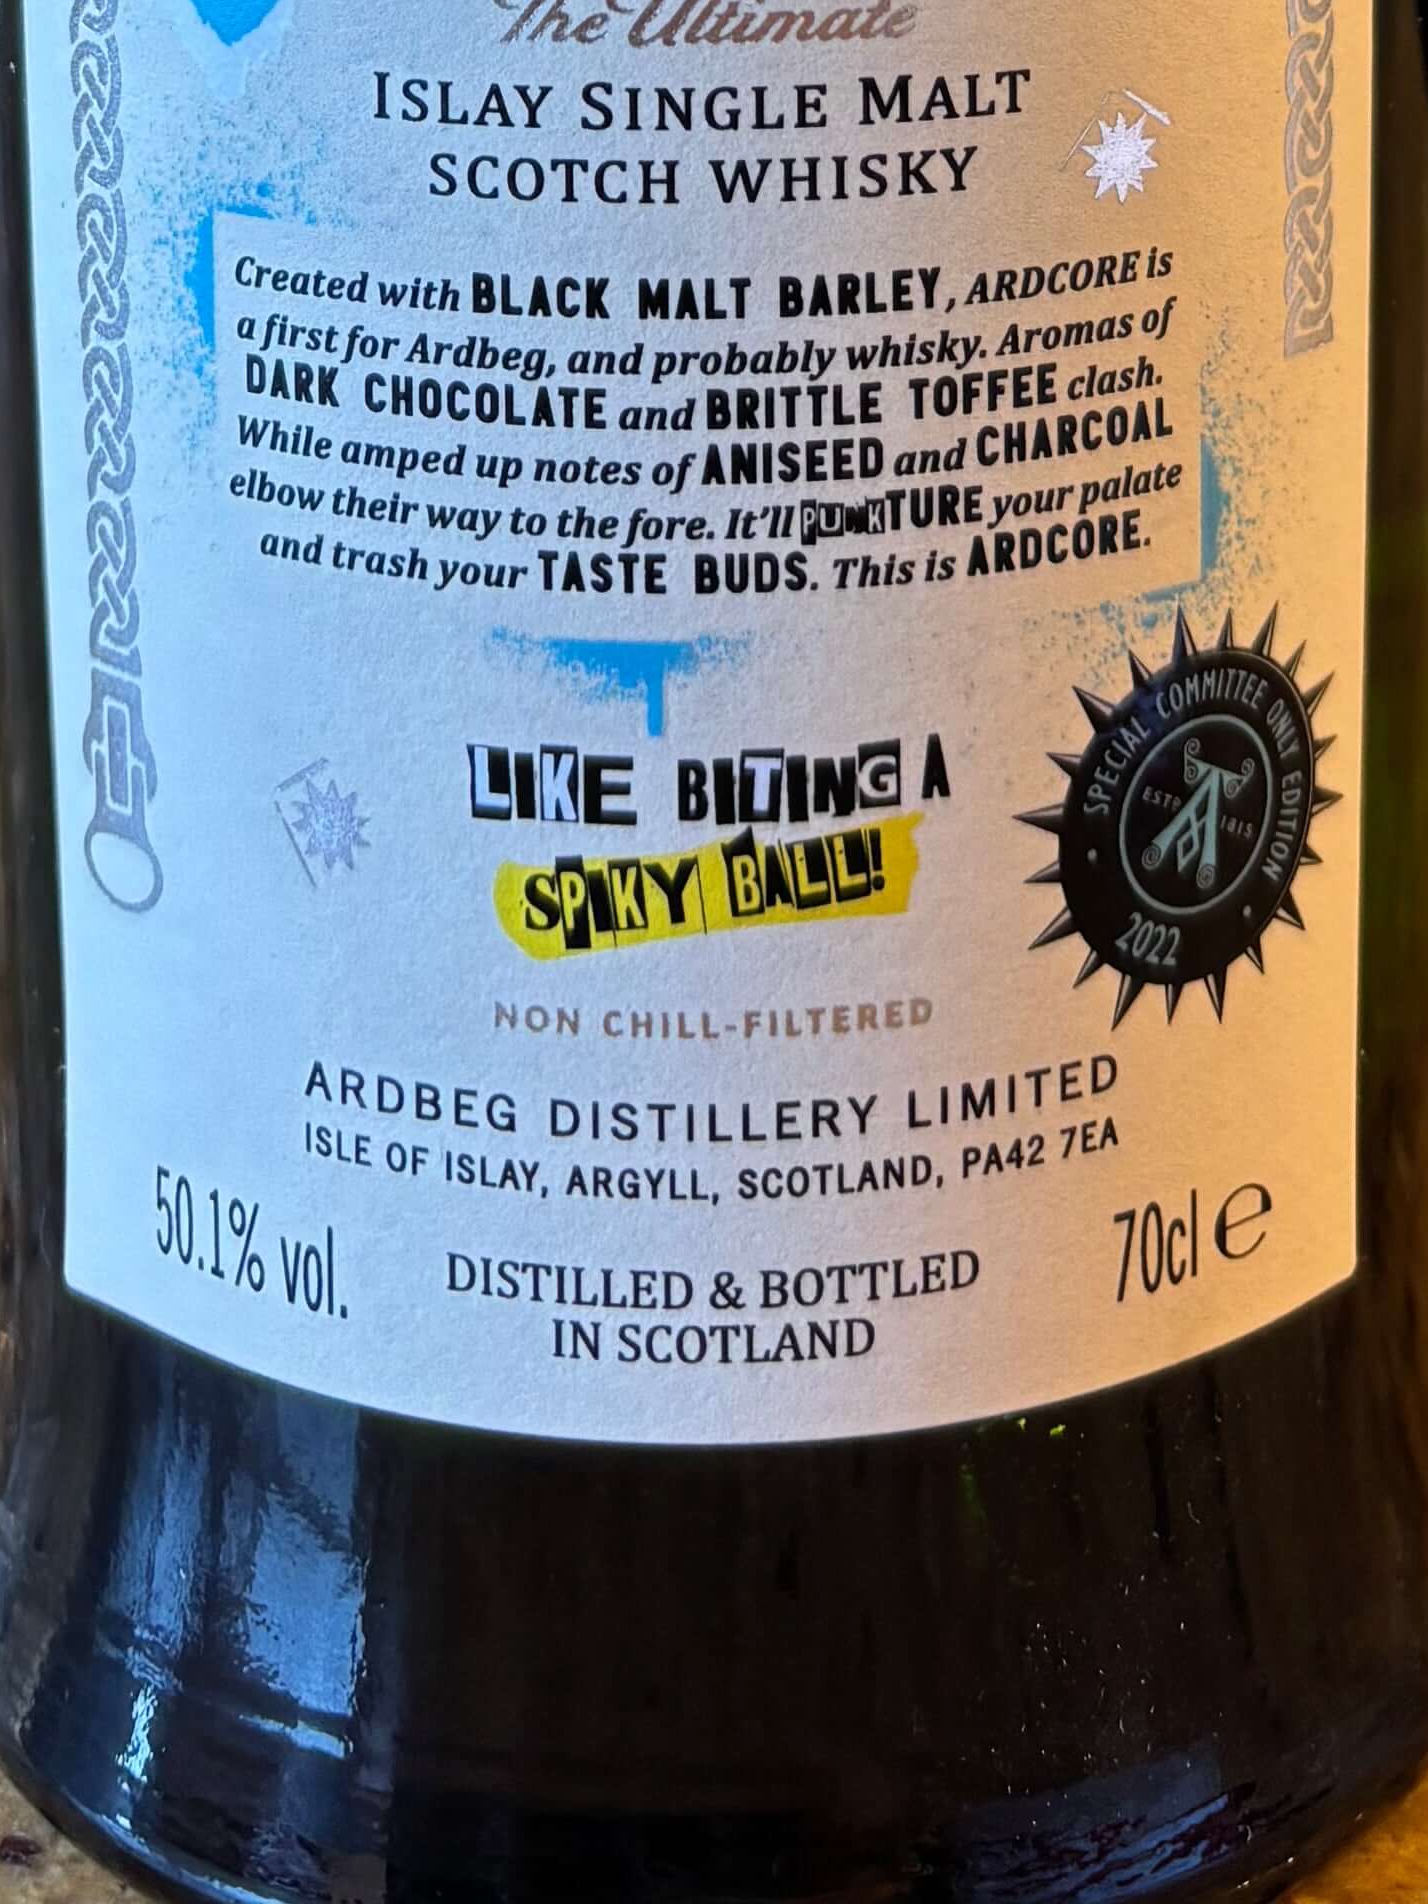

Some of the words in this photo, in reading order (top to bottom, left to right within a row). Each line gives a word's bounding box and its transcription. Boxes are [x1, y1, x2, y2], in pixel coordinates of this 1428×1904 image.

[374, 71, 553, 128] ISLAY
[581, 81, 827, 131] SINGLE
[858, 69, 1030, 125] MALT
[430, 153, 680, 205] SCOTCH
[708, 146, 978, 204] WHISKY
[235, 256, 369, 303] Created
[378, 277, 460, 312] with
[472, 272, 610, 319] BLACK
[638, 277, 751, 320] MALT
[779, 266, 956, 318] BARLEY,
[964, 250, 1141, 305] ARDCORE
[1146, 246, 1173, 278] is
[237, 317, 256, 340] a
[259, 313, 339, 353] first
[340, 325, 400, 364] for
[404, 333, 556, 381] Ardbeg,
[567, 343, 644, 376] and
[651, 339, 837, 384] probably
[846, 330, 987, 371] whisky.
[995, 313, 1134, 356] Aromas
[1141, 296, 1177, 340] of
[246, 353, 340, 408] DARK
[365, 373, 607, 429] CHOCOLATE
[618, 398, 696, 431] and
[707, 381, 882, 430] BRITTLE
[908, 362, 1057, 420] TOFFEE
[1067, 355, 1162, 401] clash.
[238, 414, 332, 460] While
[341, 440, 467, 479] amped
[476, 454, 523, 488] up
[533, 456, 642, 486] notes
[652, 453, 697, 495] of
[701, 437, 883, 485] ANISEED
[894, 437, 967, 477] and
[976, 397, 1173, 467] CHARCOAL
[230, 468, 325, 512] elbow
[332, 485, 419, 525] their
[426, 504, 502, 541] way
[510, 507, 547, 536] to
[557, 506, 619, 539] the
[620, 508, 715, 549] fore.
[987, 485, 1074, 530] your
[1078, 462, 1183, 515] palate
[260, 534, 324, 565] and
[333, 541, 428, 580] trash
[434, 560, 528, 591] your
[537, 550, 667, 595] TASTE
[695, 551, 818, 595] BUDS.
[833, 554, 915, 590] This
[924, 550, 956, 582] is
[967, 508, 1151, 578] ARDCORE.
[1156, 667, 1269, 721] COMMITTEE
[1267, 698, 1302, 758] ONLY
[467, 743, 638, 825] LIKE
[677, 738, 902, 824] BITING
[921, 732, 951, 799] A
[1083, 720, 1152, 815] SPECIAL
[1261, 769, 1302, 882] EDITION
[523, 854, 707, 951] SPIKY
[1114, 912, 1181, 966] 2022
[493, 1001, 580, 1036] NON
[602, 997, 933, 1040] CHILL-FILTERED
[305, 1060, 516, 1133] ARDBEG
[550, 1094, 878, 1143] DISTILLERY
[908, 1054, 1117, 1130] LIMITED
[306, 1122, 372, 1167] ISLE
[386, 1142, 429, 1176] OF
[446, 1150, 548, 1199] ISLAY,
[566, 1165, 719, 1206] ARGYLL,
[738, 1155, 943, 1200] SCOTLAND,
[962, 1134, 1045, 1179] PA42
[1060, 1116, 1119, 1160] 7EA
[157, 1165, 265, 1292] 50.1%
[280, 1225, 348, 1319] vol.
[447, 1252, 693, 1311] DISTILLED
[709, 1271, 746, 1310] &
[759, 1250, 979, 1309] BOTTLED
[1113, 1188, 1198, 1303] 70cl
[552, 1318, 602, 1360] IN
[618, 1318, 875, 1364] SCOTLAND
